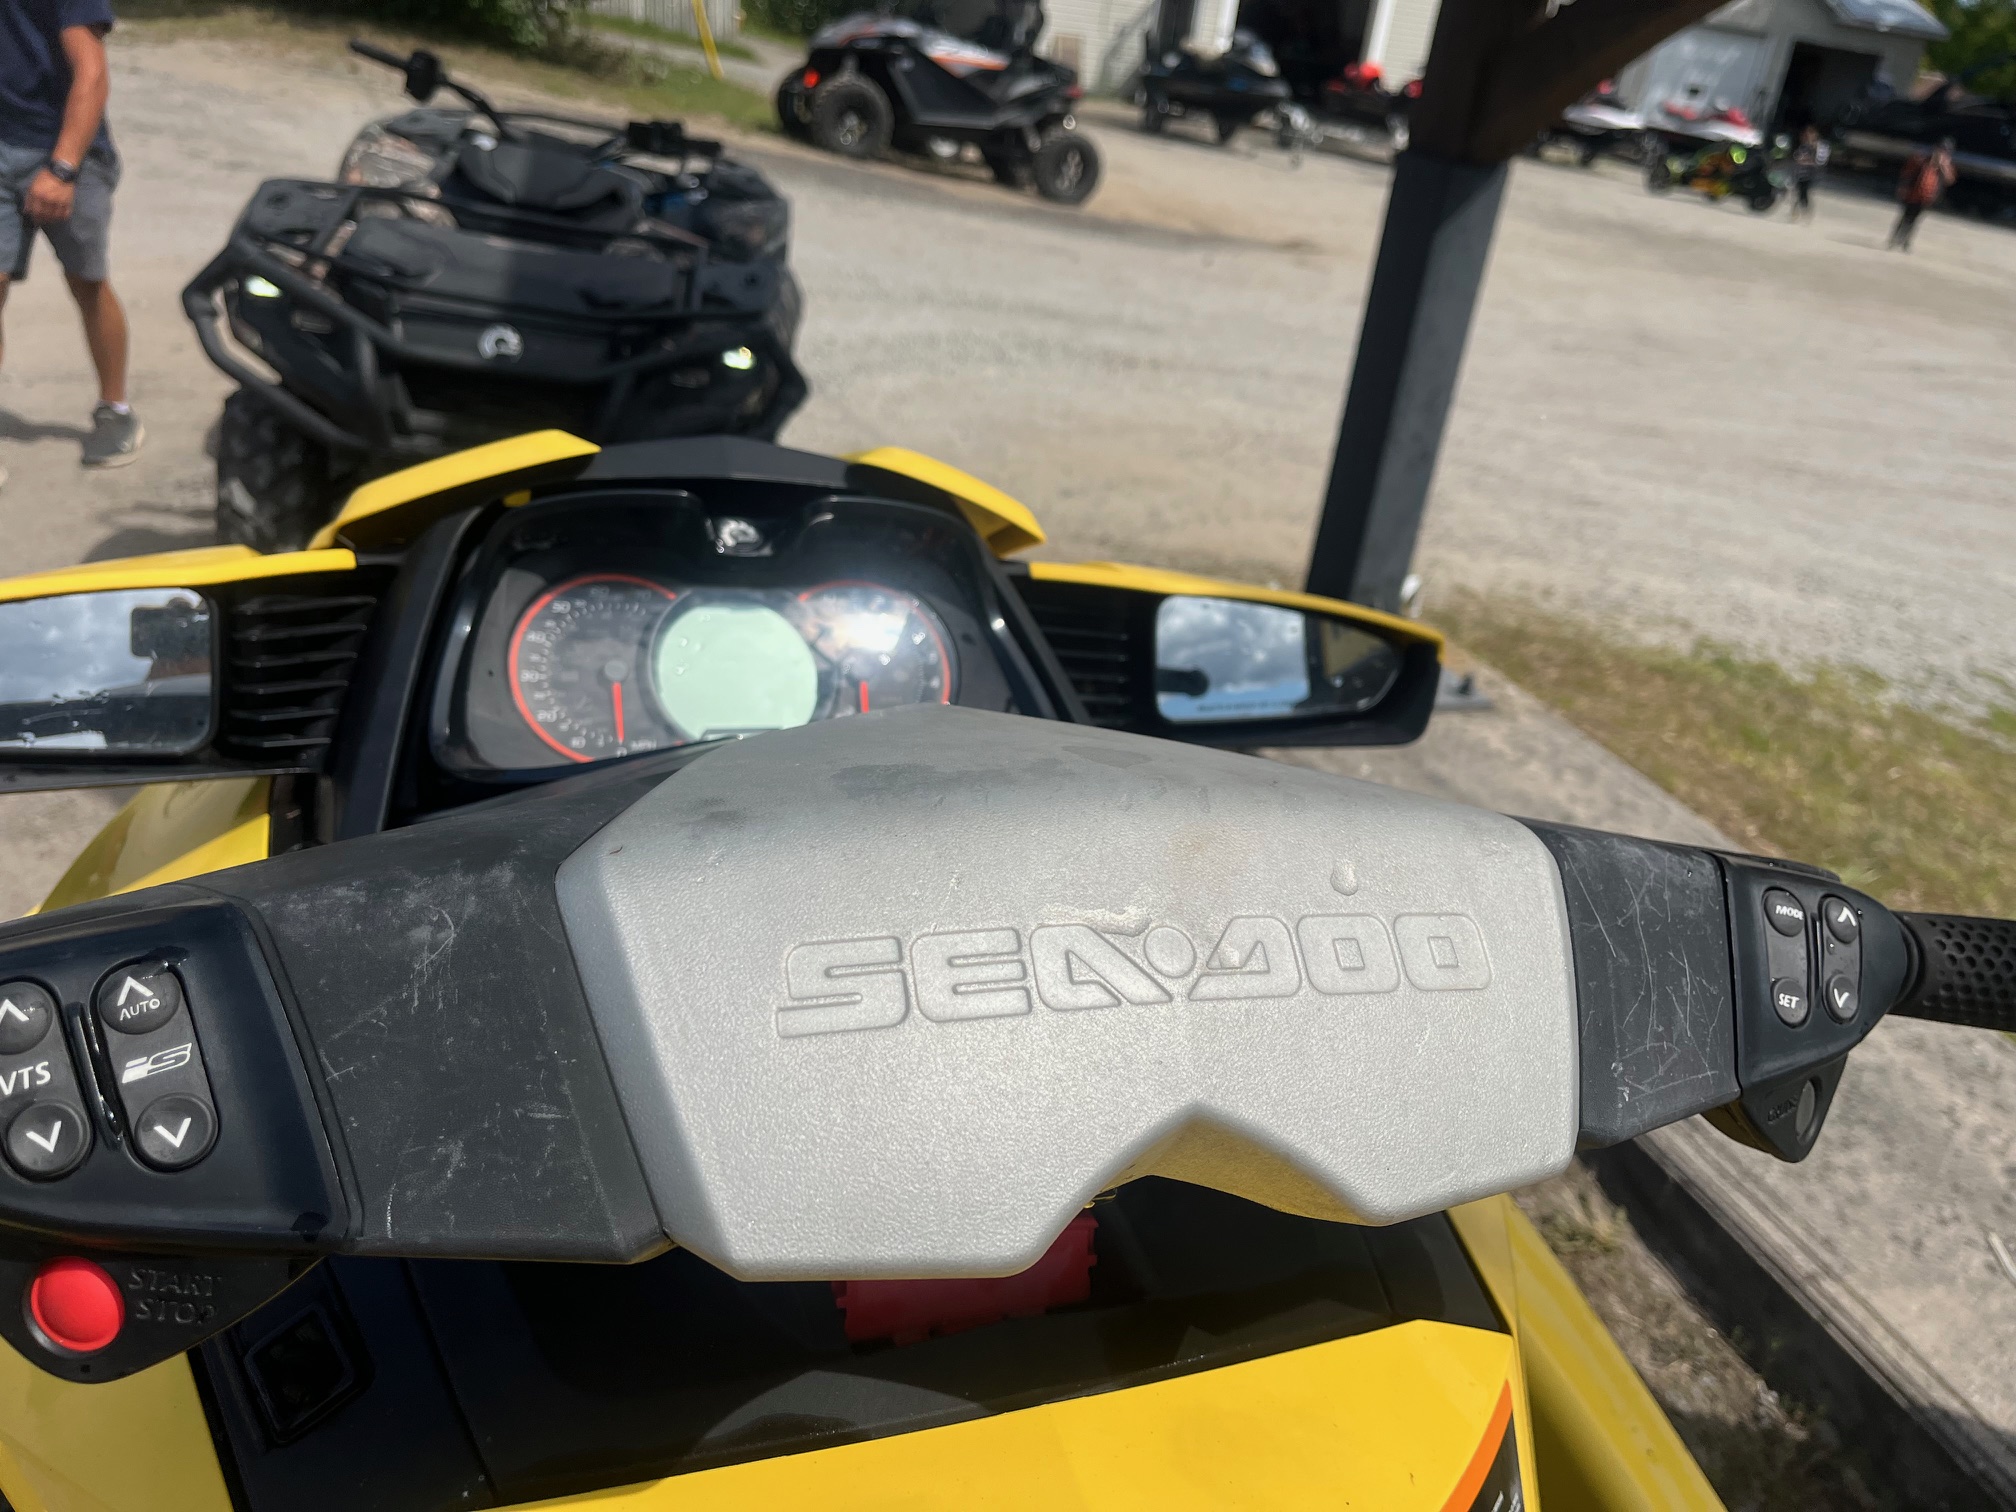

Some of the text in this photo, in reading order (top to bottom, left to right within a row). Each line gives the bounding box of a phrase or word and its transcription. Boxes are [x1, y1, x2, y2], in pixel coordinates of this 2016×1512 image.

[1775, 904, 1804, 920] MODE
[119, 998, 161, 1021] AUTO
[1778, 993, 1800, 1009] SET
[0, 1061, 51, 1096] VTS
[128, 1268, 222, 1297] START
[136, 1298, 215, 1324] STOP
